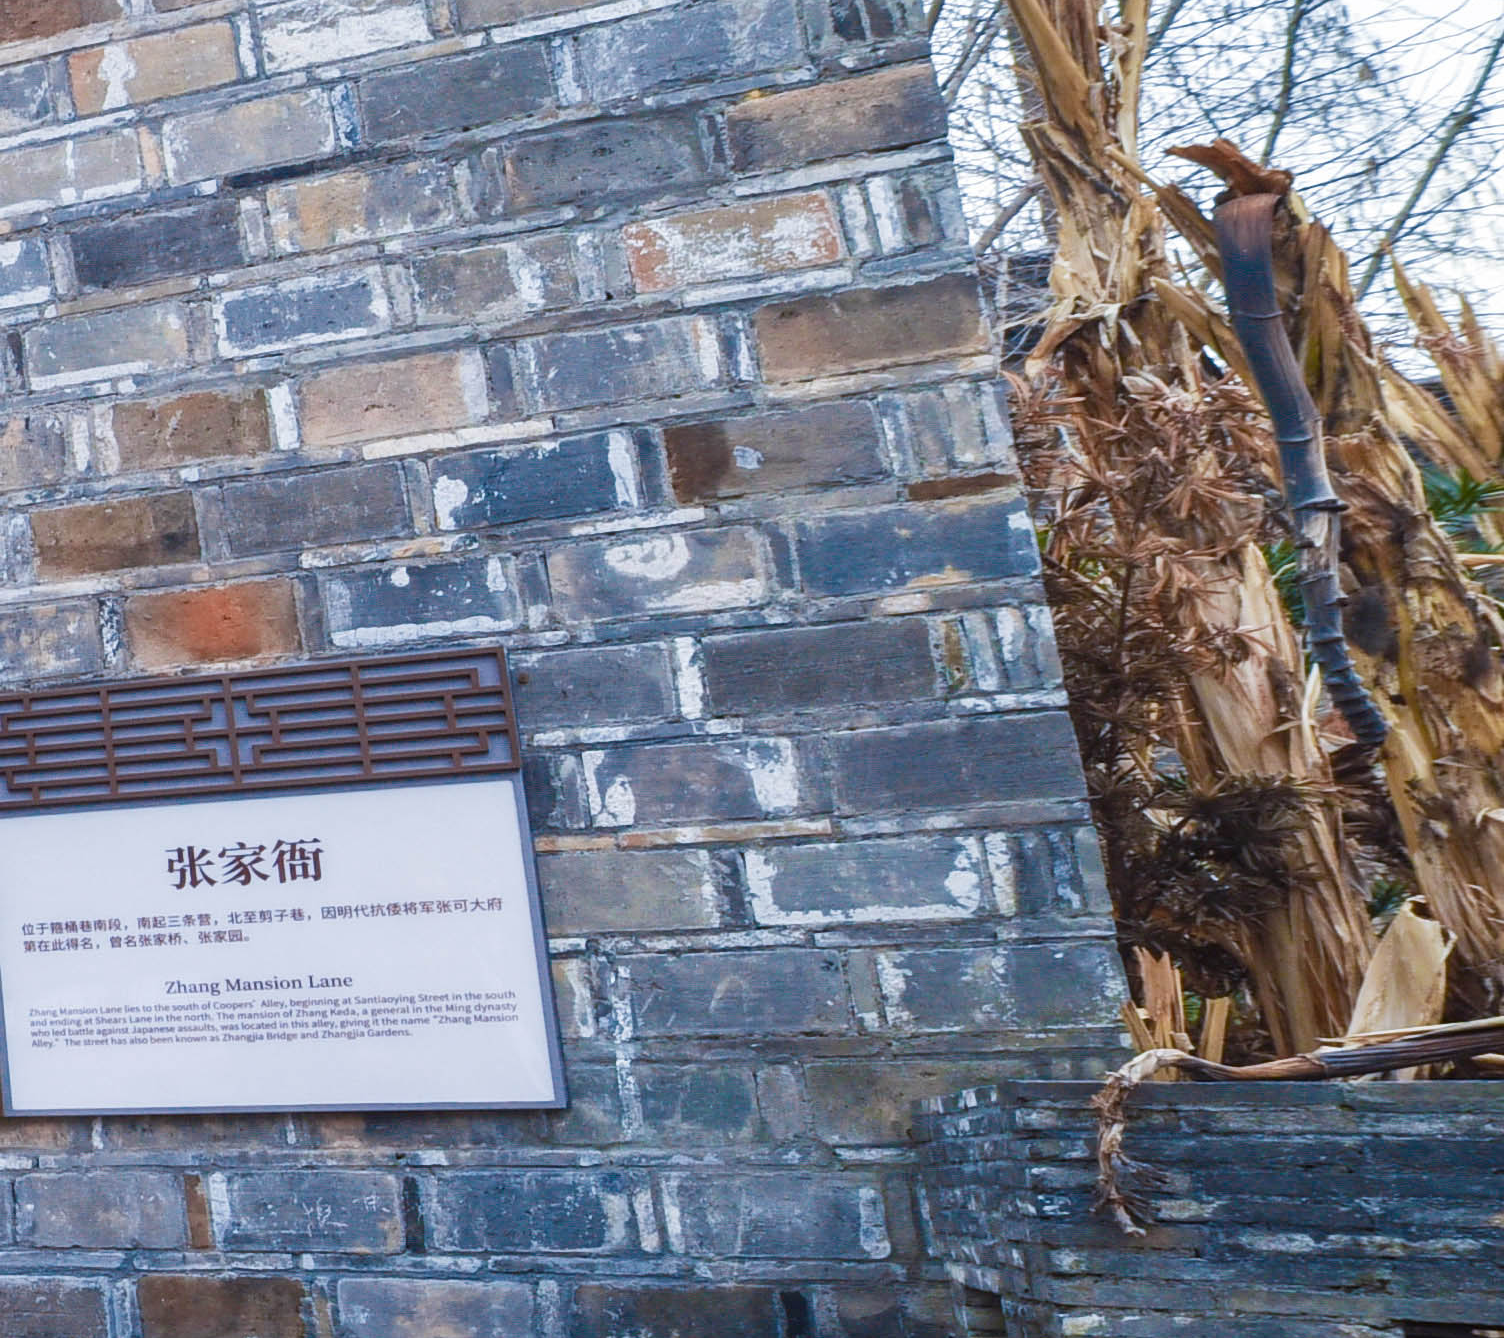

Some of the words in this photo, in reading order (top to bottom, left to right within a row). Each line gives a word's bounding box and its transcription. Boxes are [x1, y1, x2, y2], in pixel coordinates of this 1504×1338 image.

[165, 838, 324, 889] 张家衙
[165, 979, 221, 996] Zhang
[225, 976, 303, 992] Mansion
[308, 975, 353, 989] Lane
[29, 1009, 57, 1017] Zhang
[60, 1007, 97, 1015] Mansion
[100, 1006, 122, 1014] Lane
[124, 1005, 141, 1013] lies
[154, 1004, 170, 1012] the
[172, 1001, 199, 1010] south
[201, 1000, 210, 1009] of
[260, 999, 287, 1009] Alley,
[289, 997, 339, 1008] beginning
[355, 994, 416, 1004] Santiaoying
[418, 993, 448, 1002] Street
[464, 991, 482, 1000] the
[485, 990, 515, 999] south
[50, 1018, 82, 1027] ending
[96, 1016, 126, 1024] Shears
[130, 1015, 152, 1023] Lane
[184, 1013, 214, 1021] north.
[217, 1012, 234, 1020] The
[238, 1010, 280, 1019] mansion
[283, 1009, 292, 1017] of
[296, 1009, 327, 1018] Zhang
[330, 1007, 359, 1017] Keda,
[371, 1005, 409, 1016] general
[413, 1004, 422, 1013] in
[425, 1004, 442, 1012] the
[447, 1003, 471, 1013] Ming
[474, 1002, 517, 1012] dynasty
[31, 1029, 50, 1037] who
[52, 1028, 66, 1036] led
[68, 1027, 94, 1036] battle
[96, 1026, 129, 1036] against
[132, 1025, 175, 1034] Japanese
[178, 1022, 218, 1032] assaults,
[242, 1021, 277, 1030] located
[291, 1019, 309, 1028] this
[312, 1019, 338, 1029] alley,
[340, 1019, 370, 1028] giving
[381, 1017, 398, 1025] the
[401, 1017, 430, 1025] name
[474, 1014, 518, 1022] Mansion
[65, 1038, 81, 1046] The
[84, 1037, 109, 1045] street
[111, 1036, 126, 1044] has
[129, 1035, 148, 1043] also
[150, 1035, 173, 1043] been
[176, 1033, 207, 1042] known
[222, 1031, 264, 1043] Zhangjia
[266, 1030, 297, 1041] Bridge
[300, 1029, 318, 1039] and
[321, 1028, 364, 1040] Zhangjia
[367, 1027, 413, 1038] Gardens.
